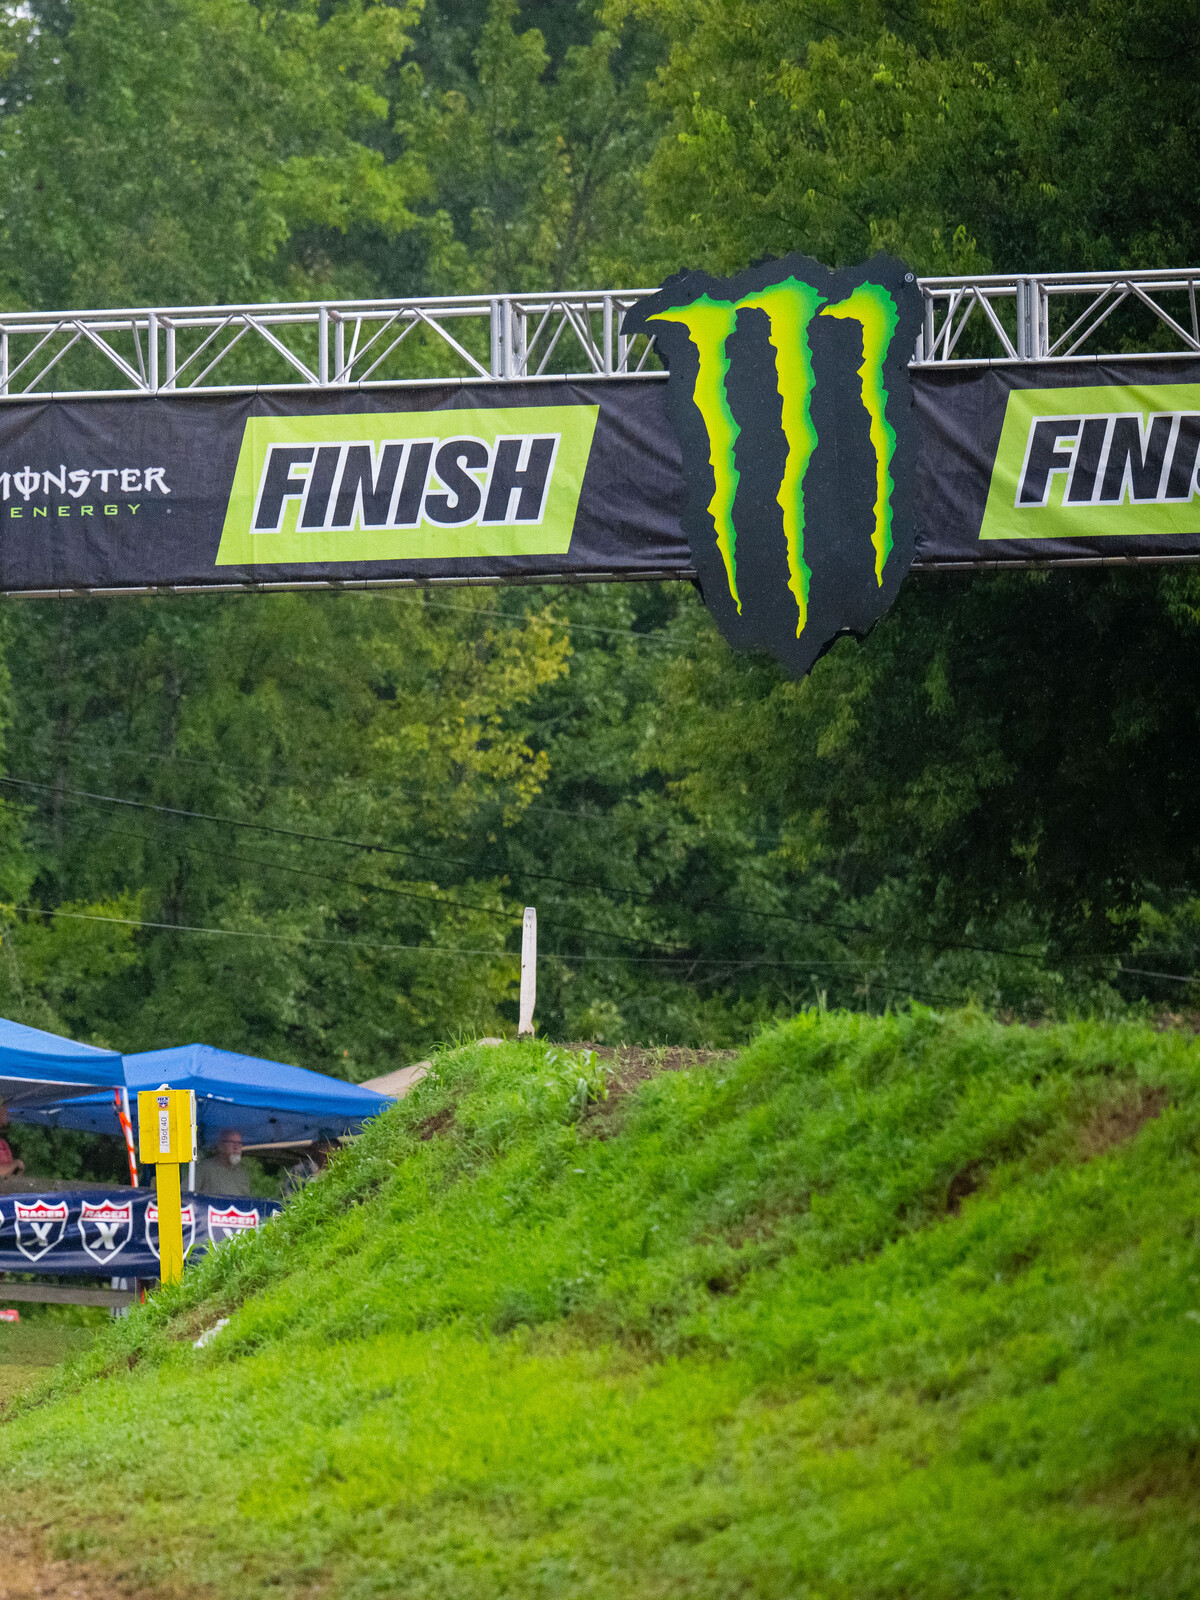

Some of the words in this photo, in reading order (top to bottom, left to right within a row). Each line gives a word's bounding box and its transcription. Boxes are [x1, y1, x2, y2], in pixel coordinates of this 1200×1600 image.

[1014, 410, 1200, 508] FINI
[249, 432, 562, 535] FINISH
[10, 503, 141, 518] ENERGY
[20, 1210, 64, 1219] RACER
[85, 1210, 128, 1219] RACER
[90, 1223, 120, 1250] X
